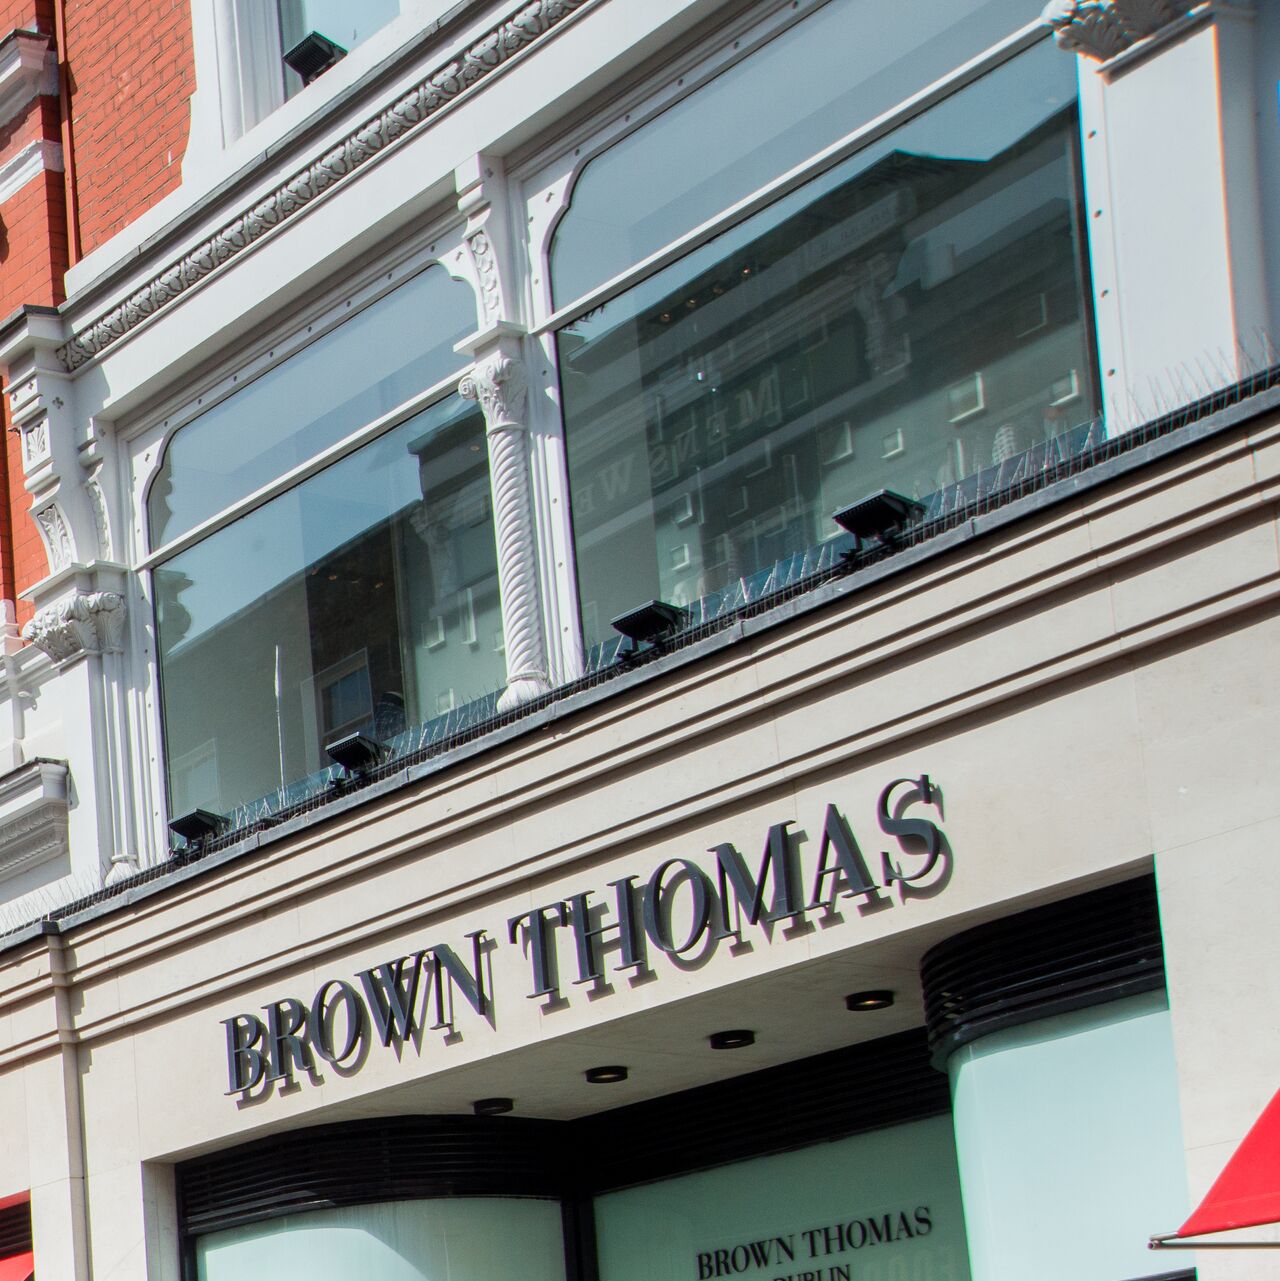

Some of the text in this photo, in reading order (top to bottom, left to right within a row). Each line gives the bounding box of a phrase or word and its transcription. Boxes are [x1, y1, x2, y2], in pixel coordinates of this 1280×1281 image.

[219, 774, 948, 1100] BROWN THOMAS
[696, 1206, 933, 1281] BROWN THOMAS
